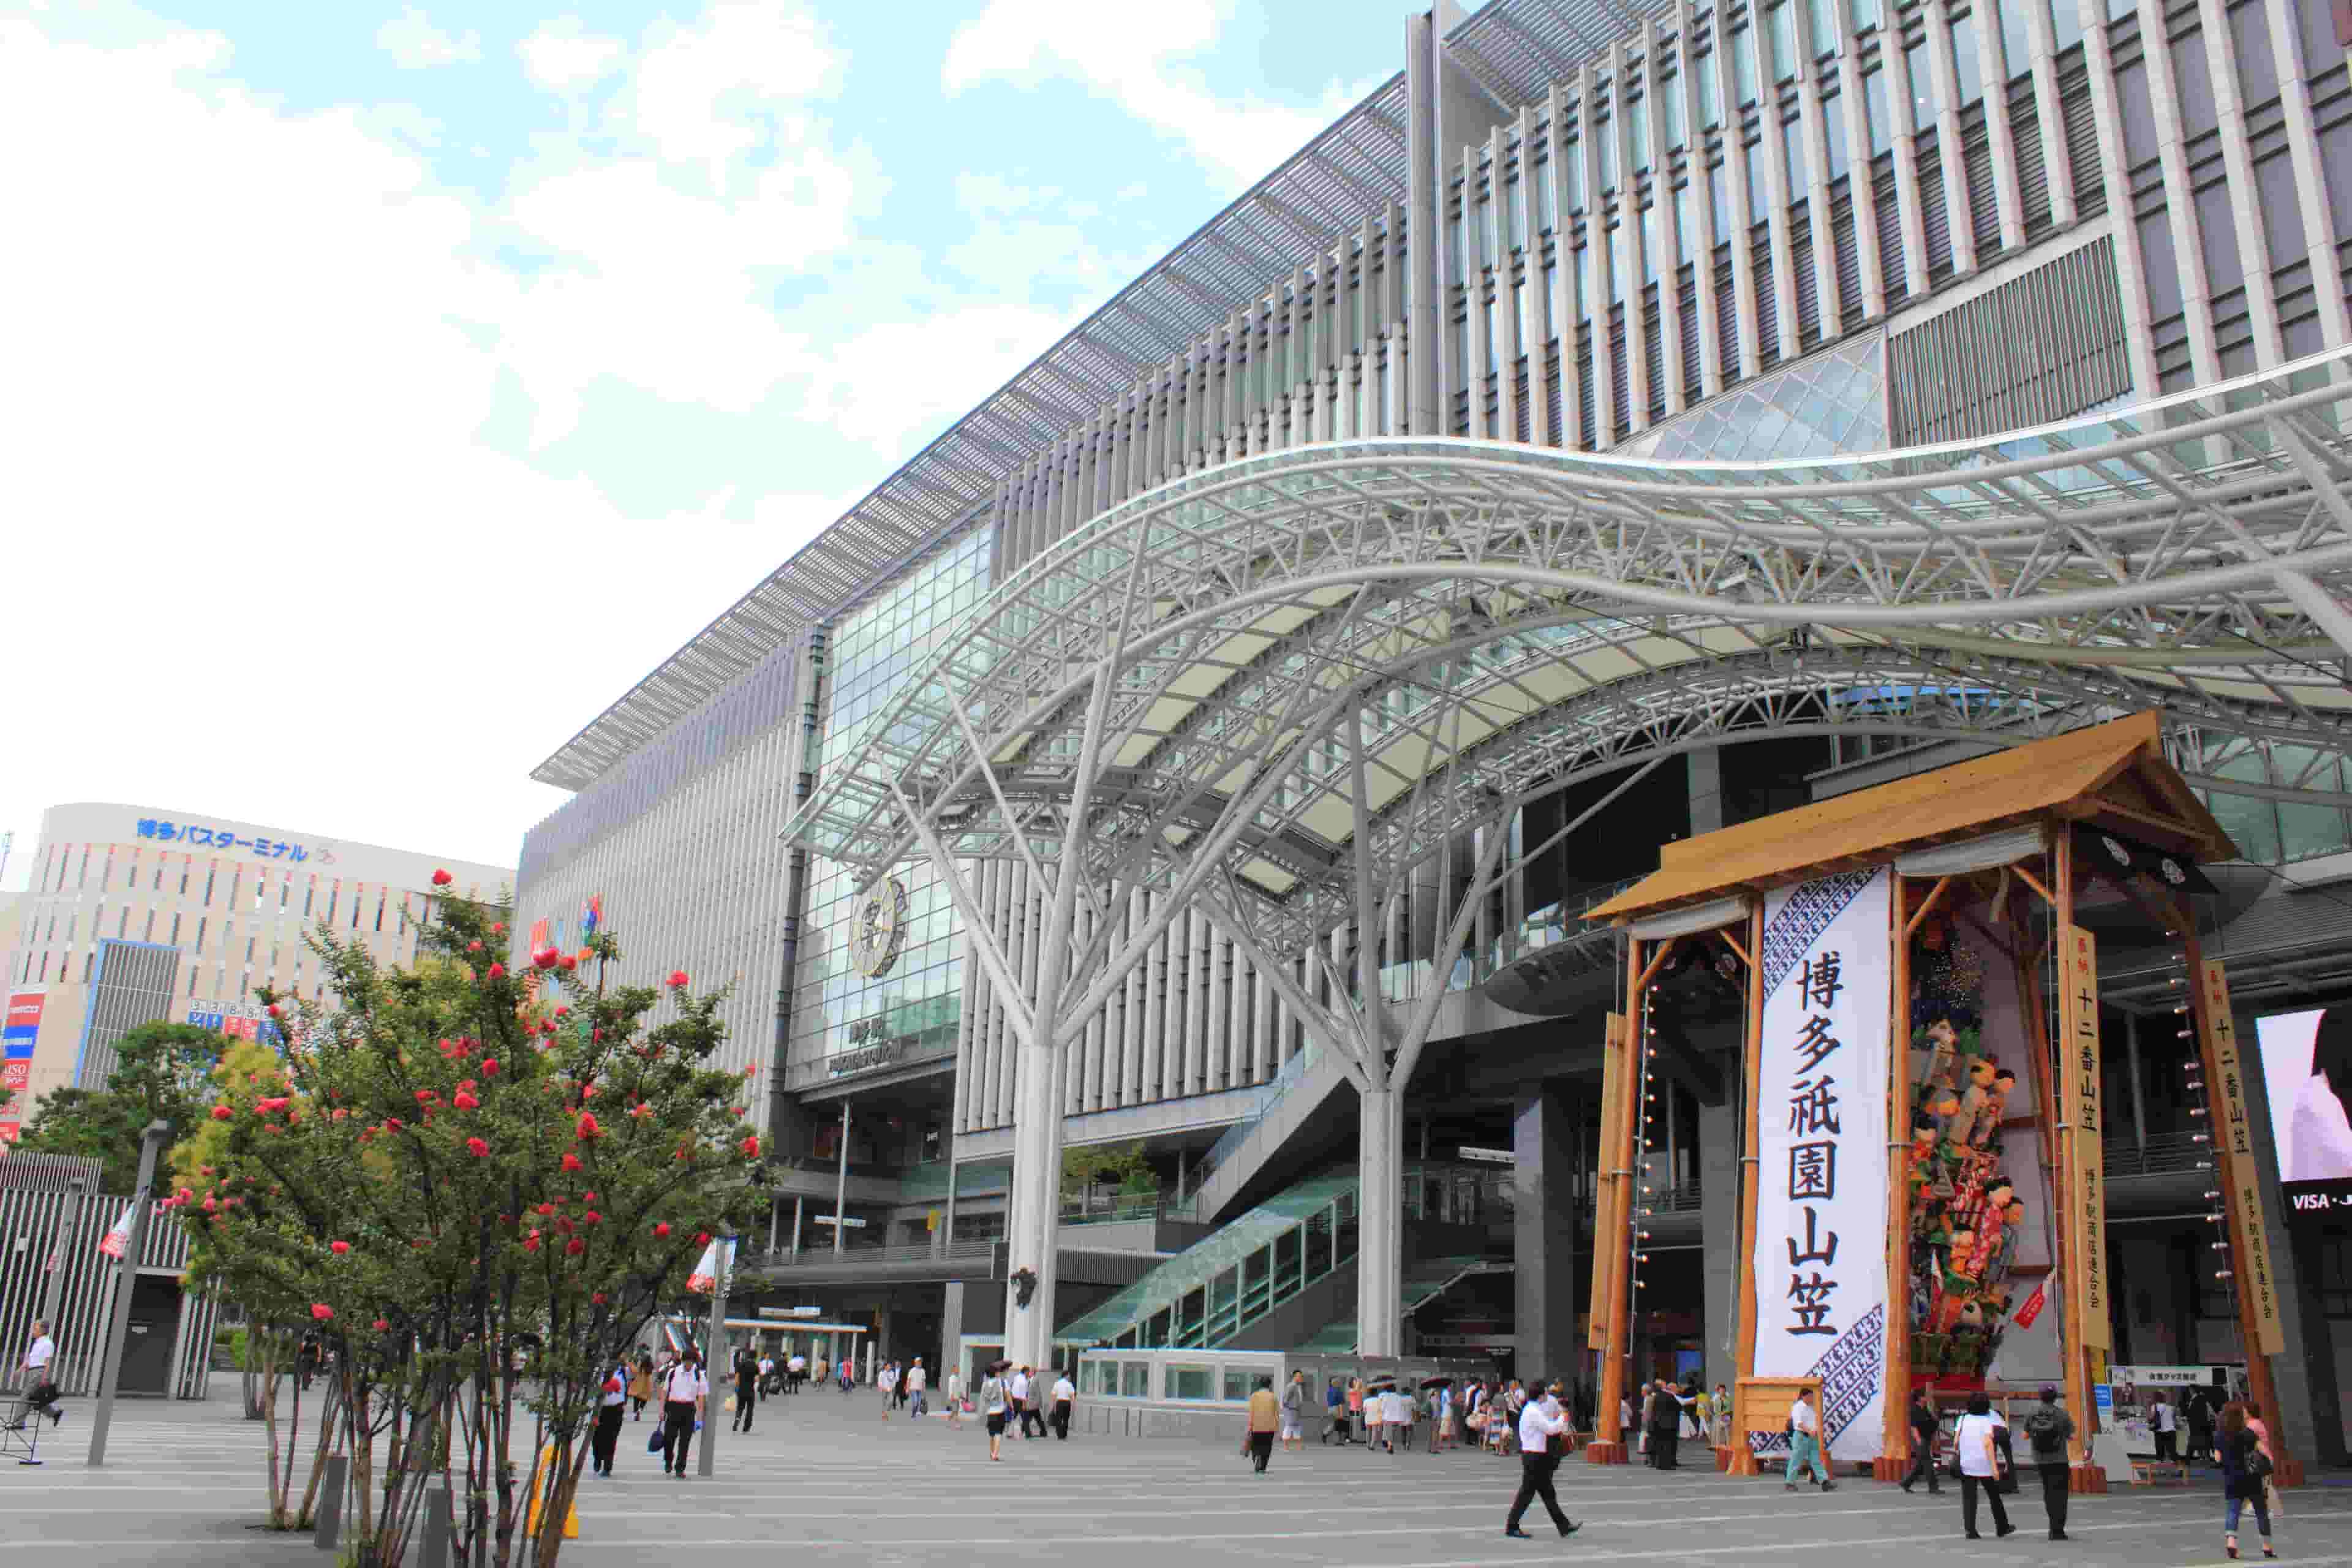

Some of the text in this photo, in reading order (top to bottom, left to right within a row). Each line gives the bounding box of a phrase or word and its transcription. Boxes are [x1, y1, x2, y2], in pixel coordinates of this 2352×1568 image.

[137, 818, 308, 862] 博多バスターミナル
[2076, 987, 2098, 1131] 十二番山笠
[1785, 951, 1844, 1336] 博多祇園山笠
[2293, 1194, 2330, 1209] VISA
